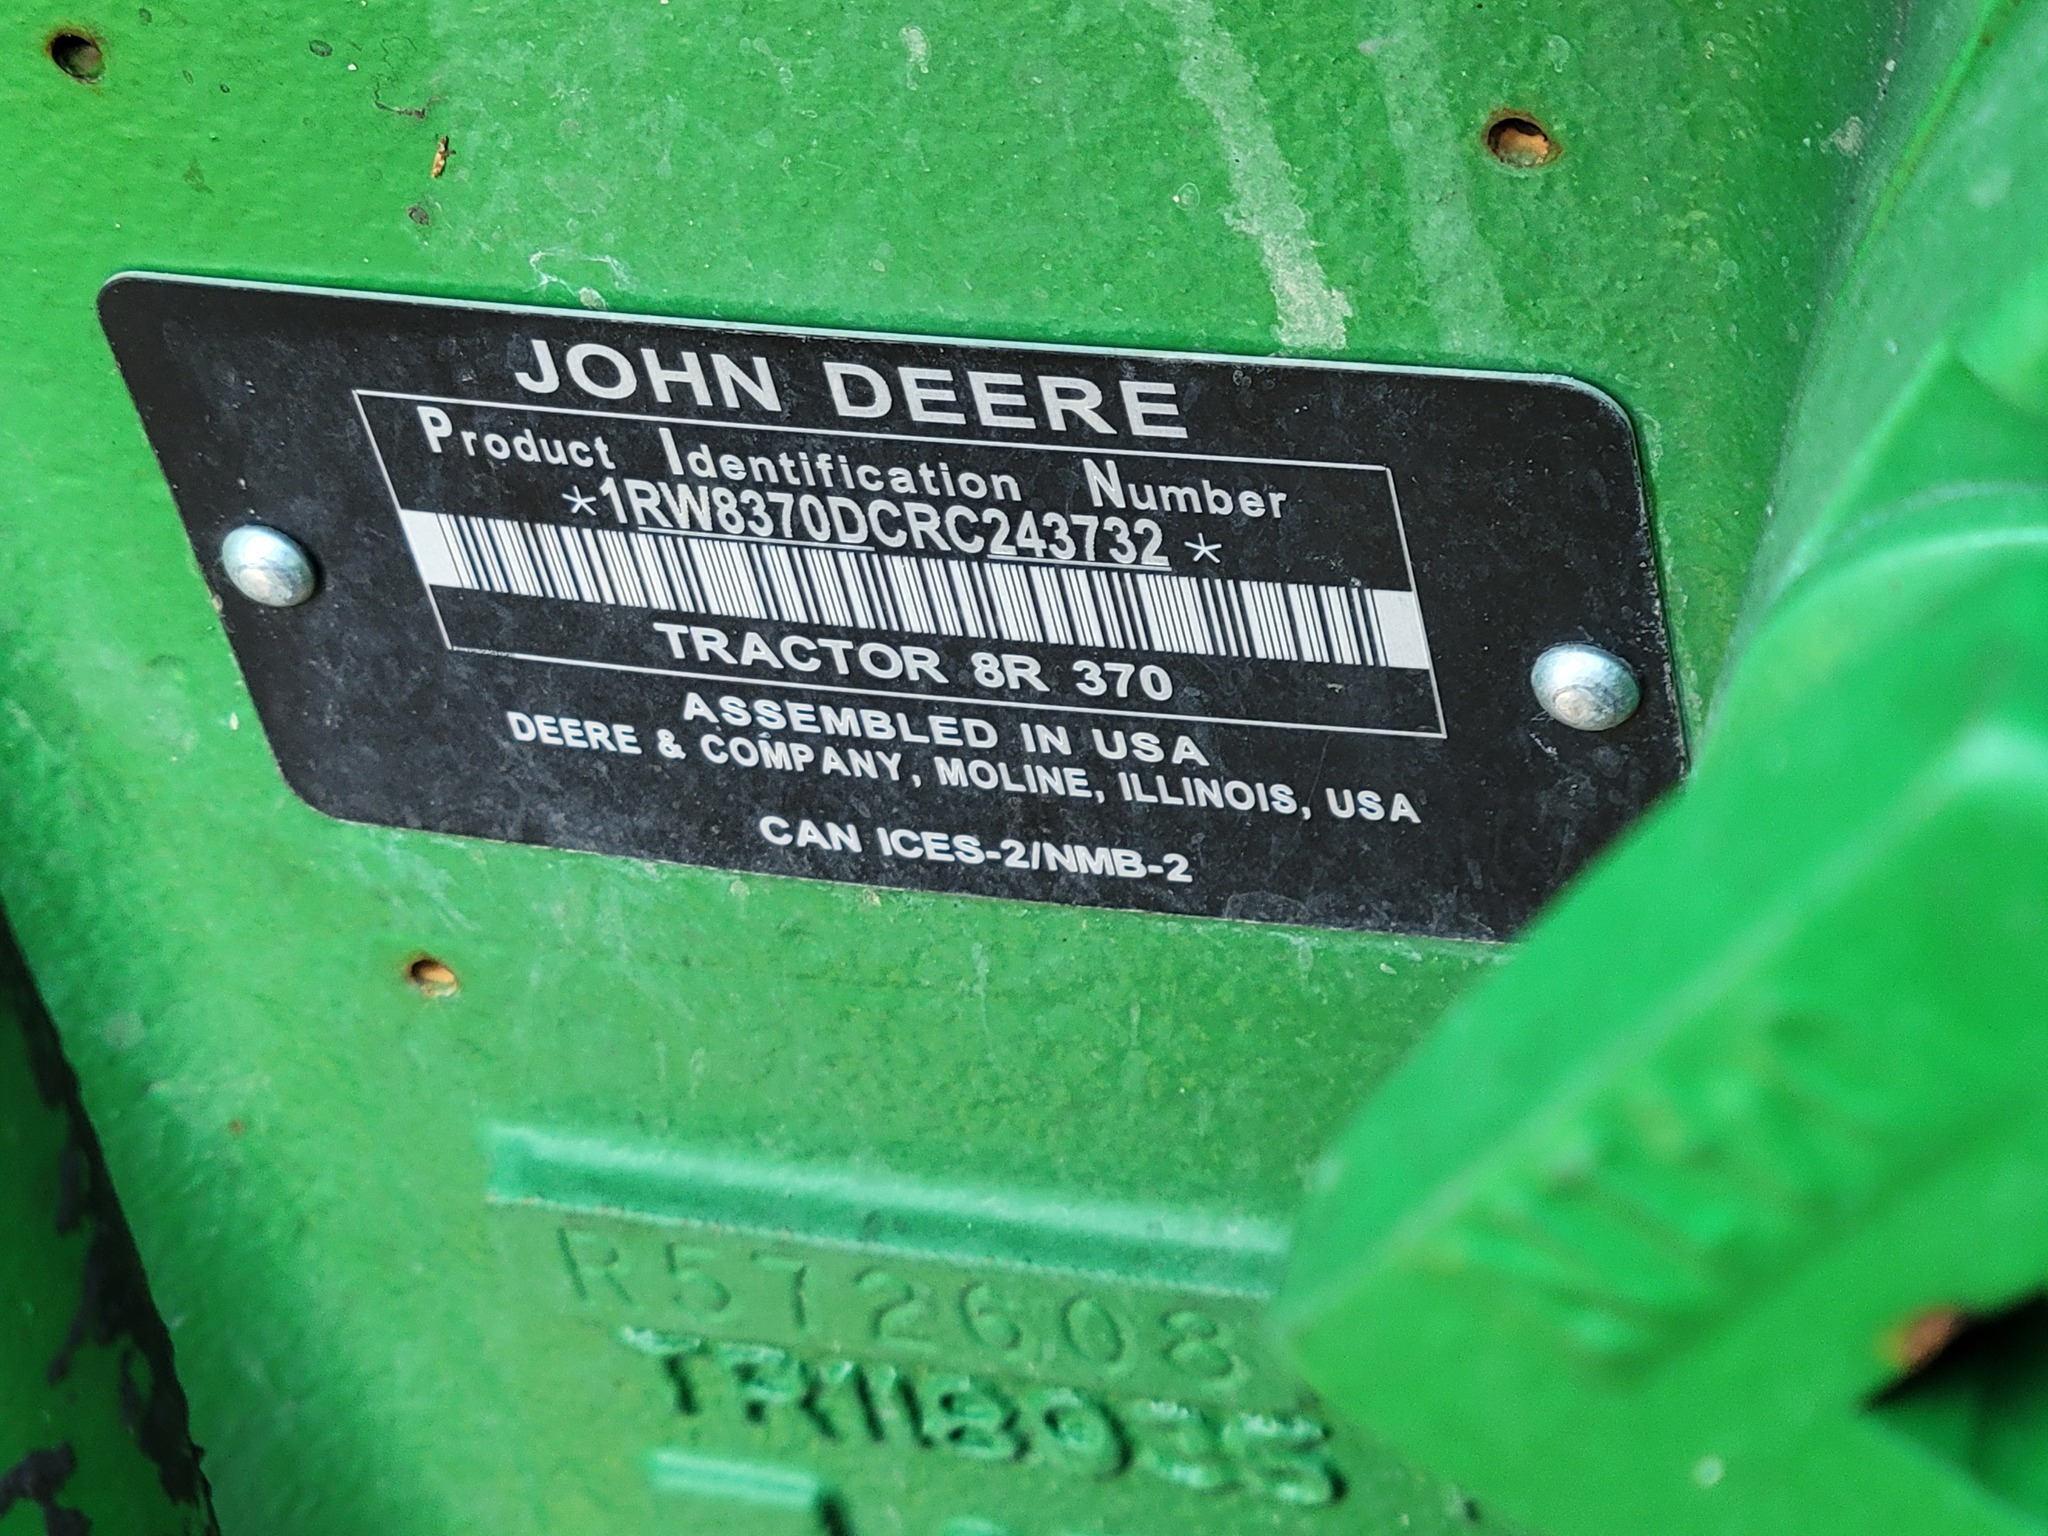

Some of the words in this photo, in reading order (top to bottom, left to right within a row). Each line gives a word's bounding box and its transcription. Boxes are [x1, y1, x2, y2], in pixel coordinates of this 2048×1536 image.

[515, 340, 781, 412] JOHN
[822, 361, 1188, 439] DEERE
[417, 406, 616, 469] Product
[658, 427, 1021, 501] Identification
[1083, 459, 1286, 518] Number
[653, 623, 949, 684] TRACTOR
[973, 652, 1051, 693] 8R
[1076, 660, 1174, 701] 370
[506, 711, 642, 755] DEERE
[656, 728, 687, 760] &
[934, 757, 1105, 804] MOLINE,
[1118, 772, 1311, 821] ILLINOIS,
[1325, 787, 1422, 824] USA
[683, 692, 998, 749] ASSEMBLED
[1020, 723, 1073, 756] IN
[1092, 729, 1210, 767] USA
[759, 816, 863, 853] CAN
[876, 827, 1194, 884] ICES-2/NMB-2
[555, 1226, 1250, 1392] R572608
